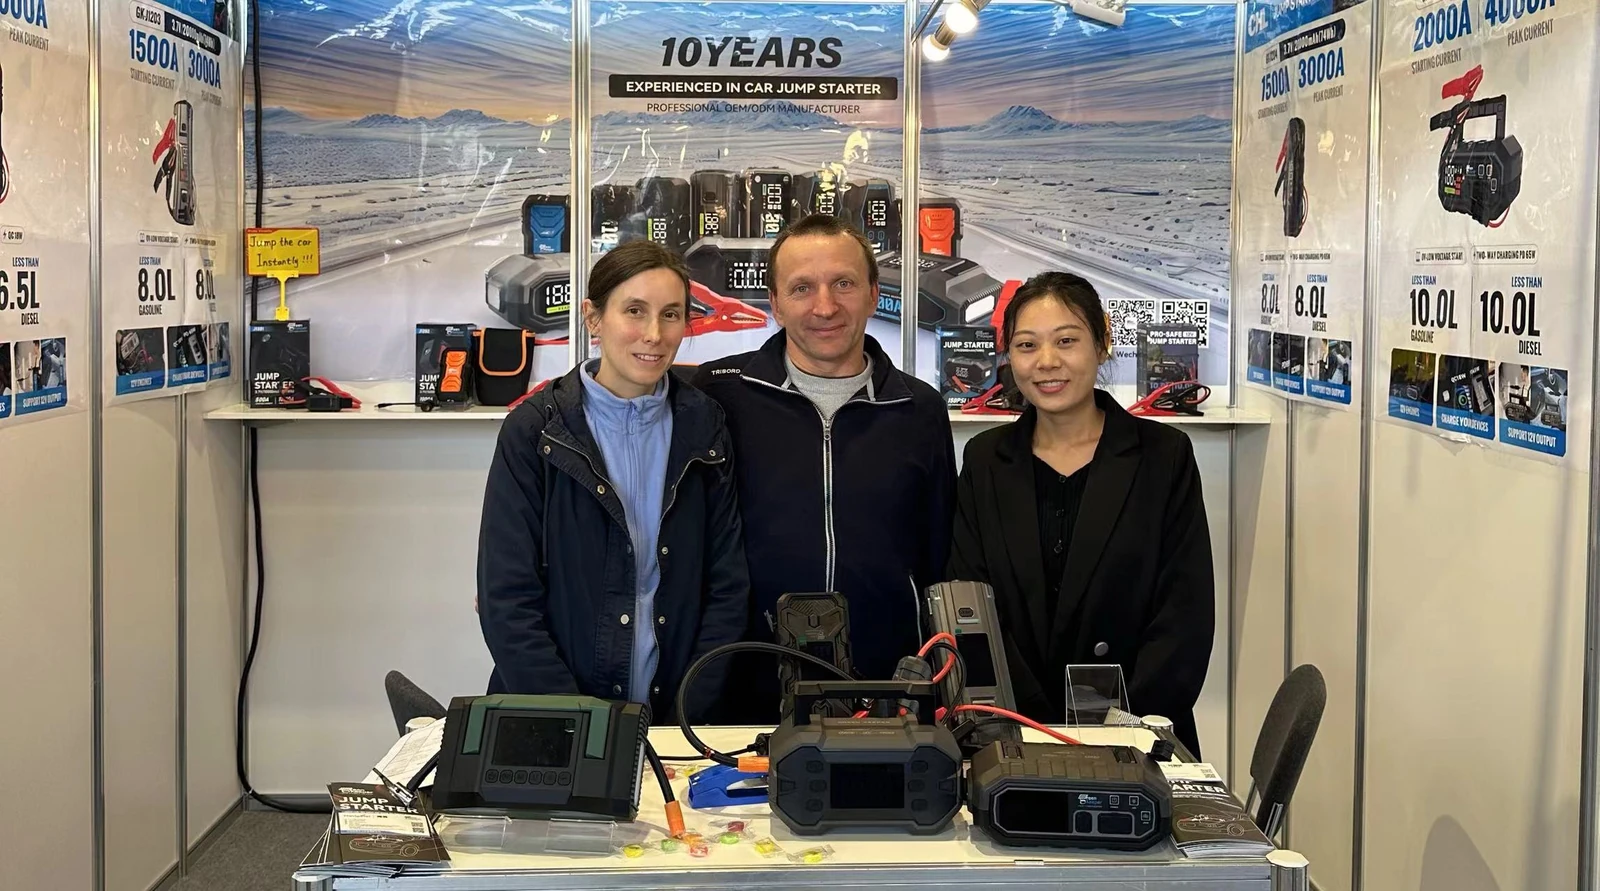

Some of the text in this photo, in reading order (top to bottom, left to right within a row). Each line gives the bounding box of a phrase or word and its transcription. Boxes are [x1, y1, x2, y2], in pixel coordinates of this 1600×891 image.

[1247, 8, 1269, 37] CHL
[1414, 0, 1556, 52] 2000A 400
[9, 27, 49, 52] PEAK CURRENT
[1507, 18, 1554, 47] PEAK CURRENT
[129, 28, 179, 73] 1500A
[661, 36, 844, 69] 10YEARS
[1411, 47, 1462, 75] STARTING CURRENT
[188, 48, 222, 90] 3000A
[1261, 46, 1345, 102] 1500A 3000A
[152, 73, 175, 90] CURRENT
[626, 81, 881, 95] EXPERIENCED IN CAR JUMP STARTER
[647, 103, 860, 114] PROFESSIONAL OEM/ODM MANUFACTURER
[7, 231, 15, 240] QC
[249, 236, 312, 250] Jump the car
[12, 257, 39, 267] LESS THAN
[256, 253, 299, 268] Instantly
[1487, 251, 1497, 260] WAY
[1497, 251, 1519, 260] CHARGING
[1519, 251, 1525, 259] PD
[138, 267, 176, 302] 8.0L
[1412, 275, 1436, 285] LESS THAN
[1511, 276, 1542, 288] LESS THAN
[0, 270, 40, 310] 6.5L
[1261, 283, 1280, 314] 8.0L
[1295, 284, 1328, 318] 8.0L
[139, 304, 163, 316] GASOLINE
[1409, 288, 1458, 329] 10.0L
[1480, 290, 1540, 337] 10.0L
[21, 312, 39, 325] DIESEL
[1410, 329, 1434, 343] GASOLINE
[1116, 350, 1138, 359] Wech
[1518, 339, 1542, 356] DIESEL
[254, 372, 280, 381] JUMP
[711, 368, 741, 376] TRIBORD
[254, 381, 295, 390] STARER
[1507, 427, 1557, 447] SUPPORT 12V OUTPUT
[1171, 783, 1227, 794] ARTER
[339, 796, 388, 804] JUMP
[340, 804, 418, 813] STARTER
